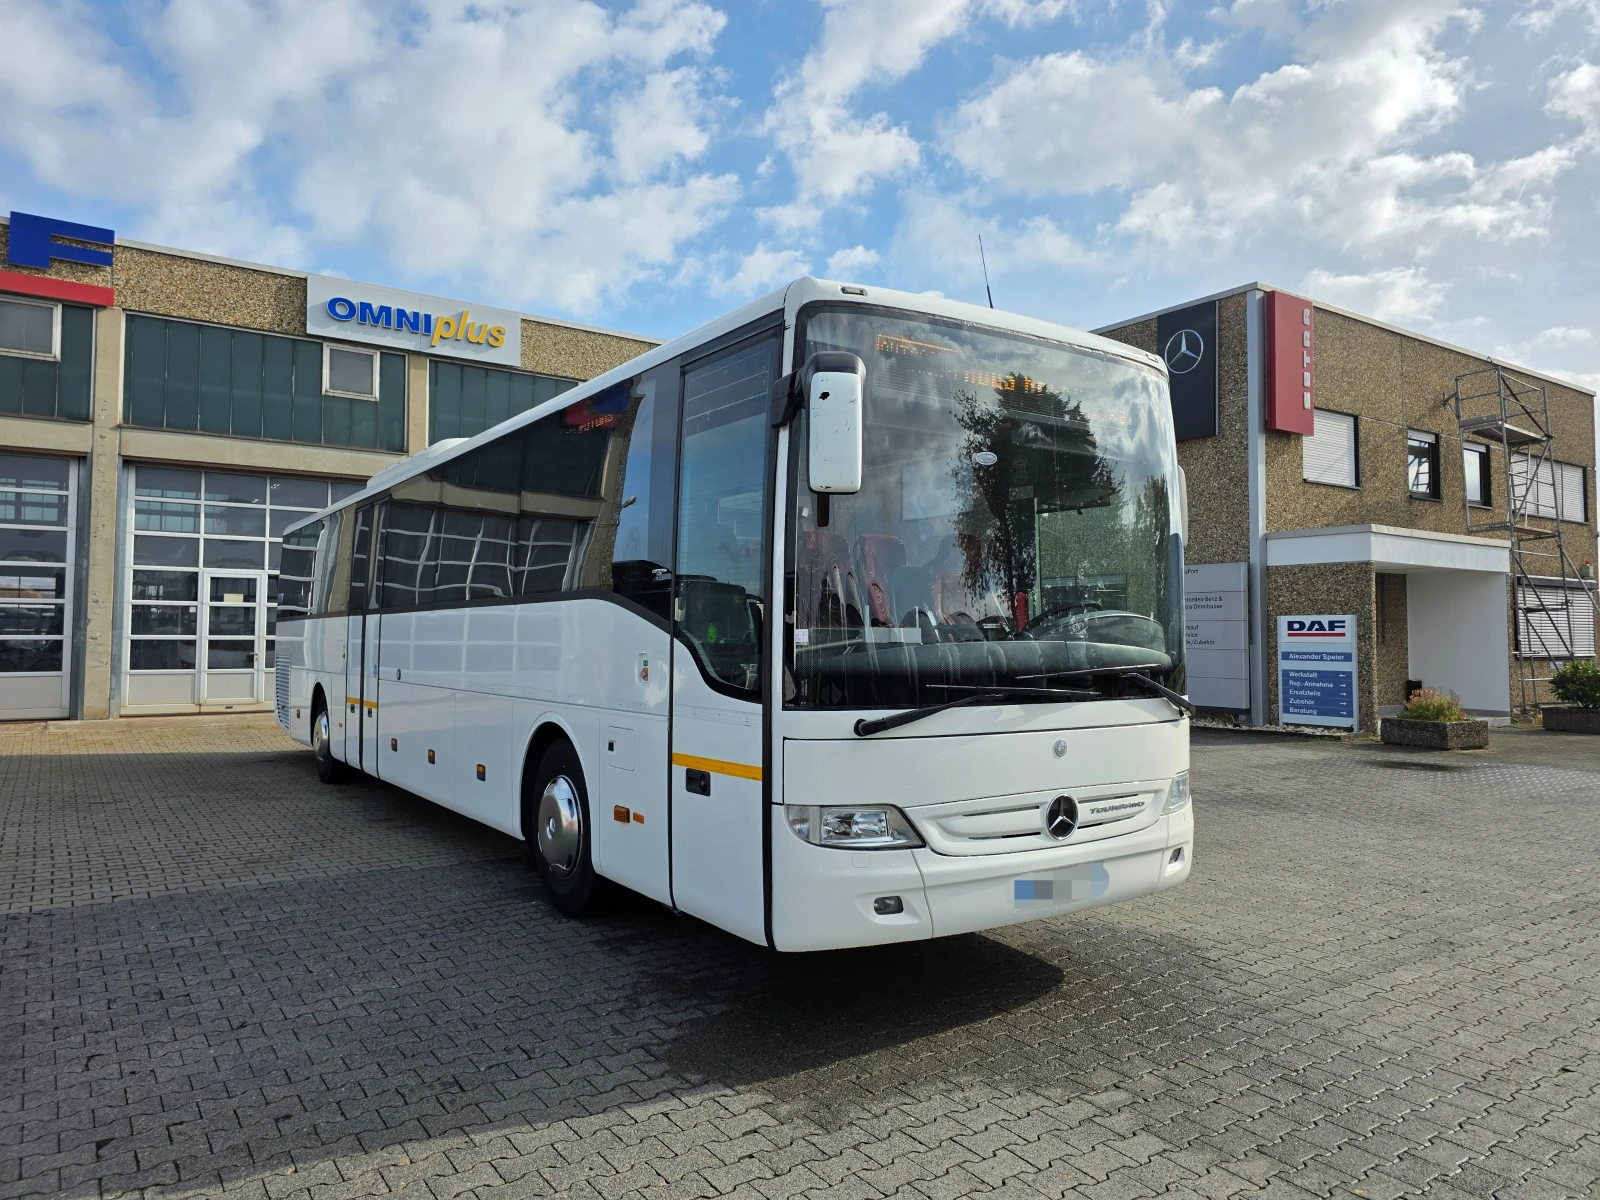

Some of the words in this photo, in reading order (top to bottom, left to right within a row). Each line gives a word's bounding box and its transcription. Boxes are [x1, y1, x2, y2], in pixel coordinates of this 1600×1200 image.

[1287, 620, 1346, 632] DAF
[1322, 653, 1345, 661] Speier
[1288, 680, 1334, 688] Rep.-Annahme
[1289, 689, 1321, 697] Ersatzteile
[1289, 707, 1317, 716] Beratung
